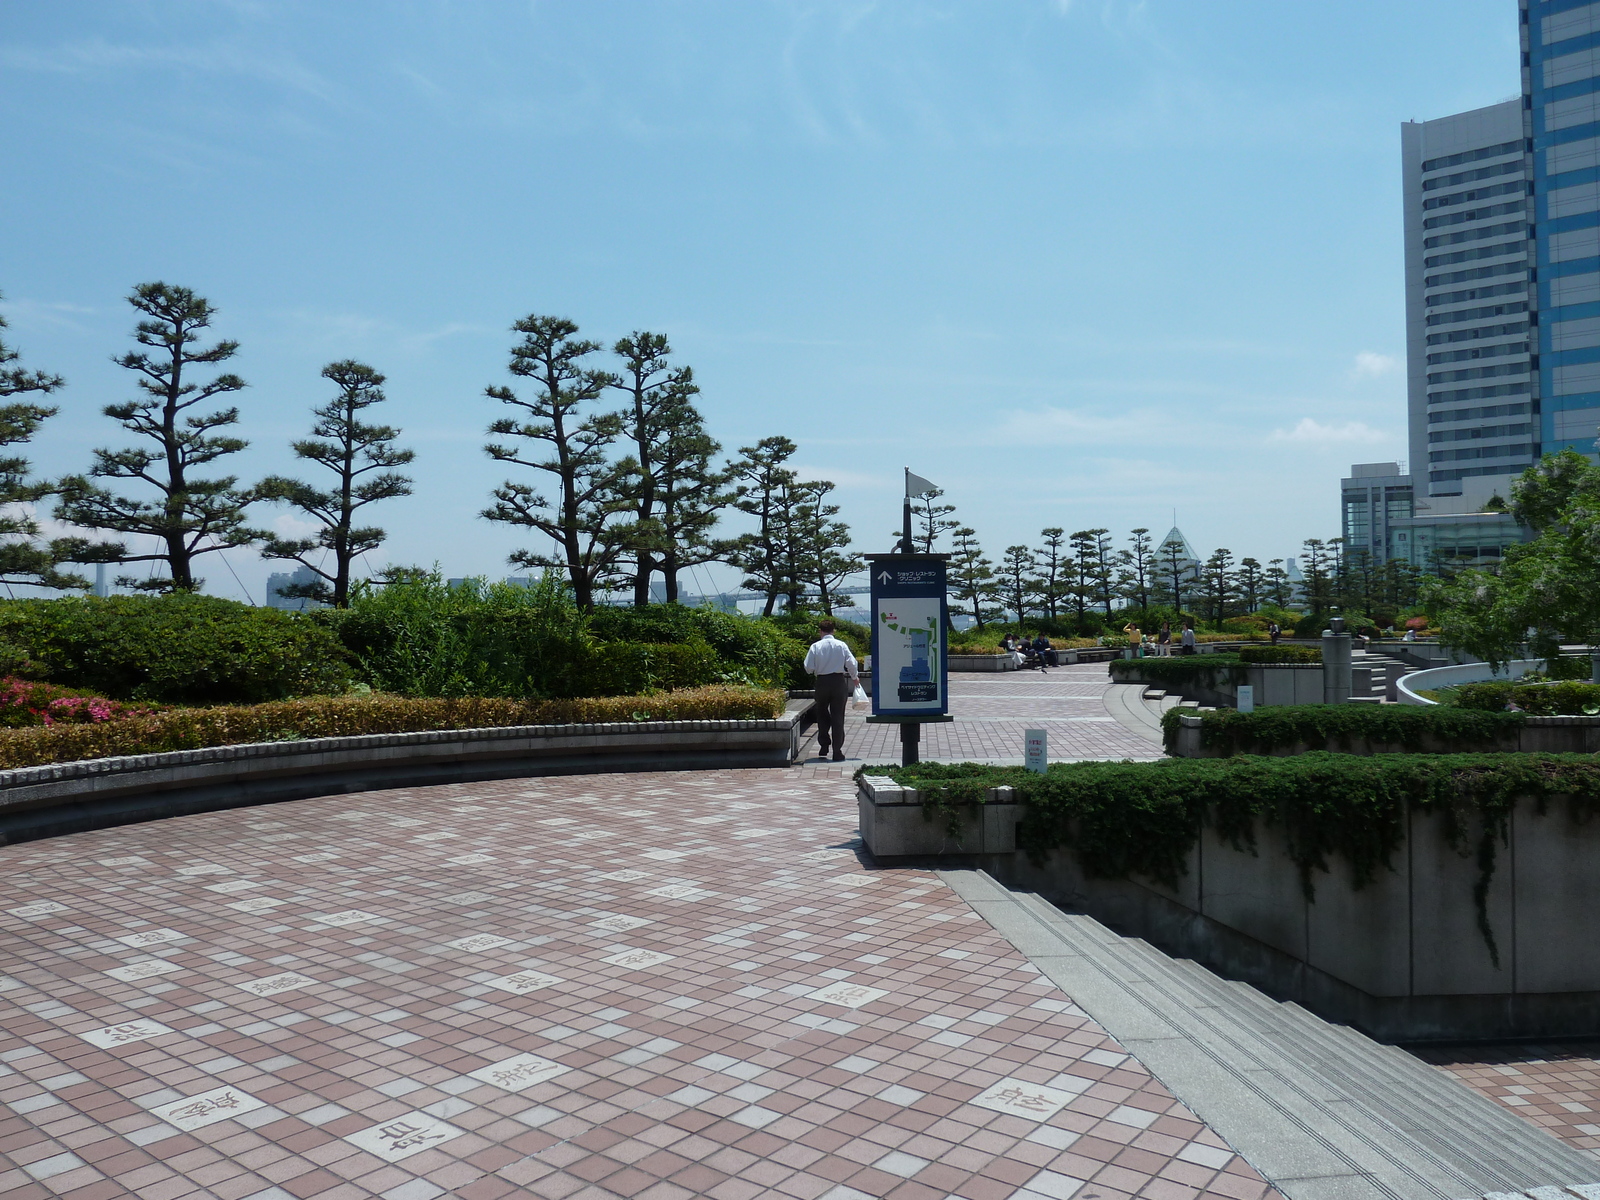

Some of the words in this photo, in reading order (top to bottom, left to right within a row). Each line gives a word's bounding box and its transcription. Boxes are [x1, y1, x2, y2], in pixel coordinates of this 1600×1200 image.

[823, 985, 871, 1005] 船
[103, 1024, 159, 1042] 船
[492, 1061, 559, 1087] 舵
[168, 1091, 240, 1121] 舷
[984, 1086, 1057, 1113] 舷
[378, 1121, 446, 1151] 舶
